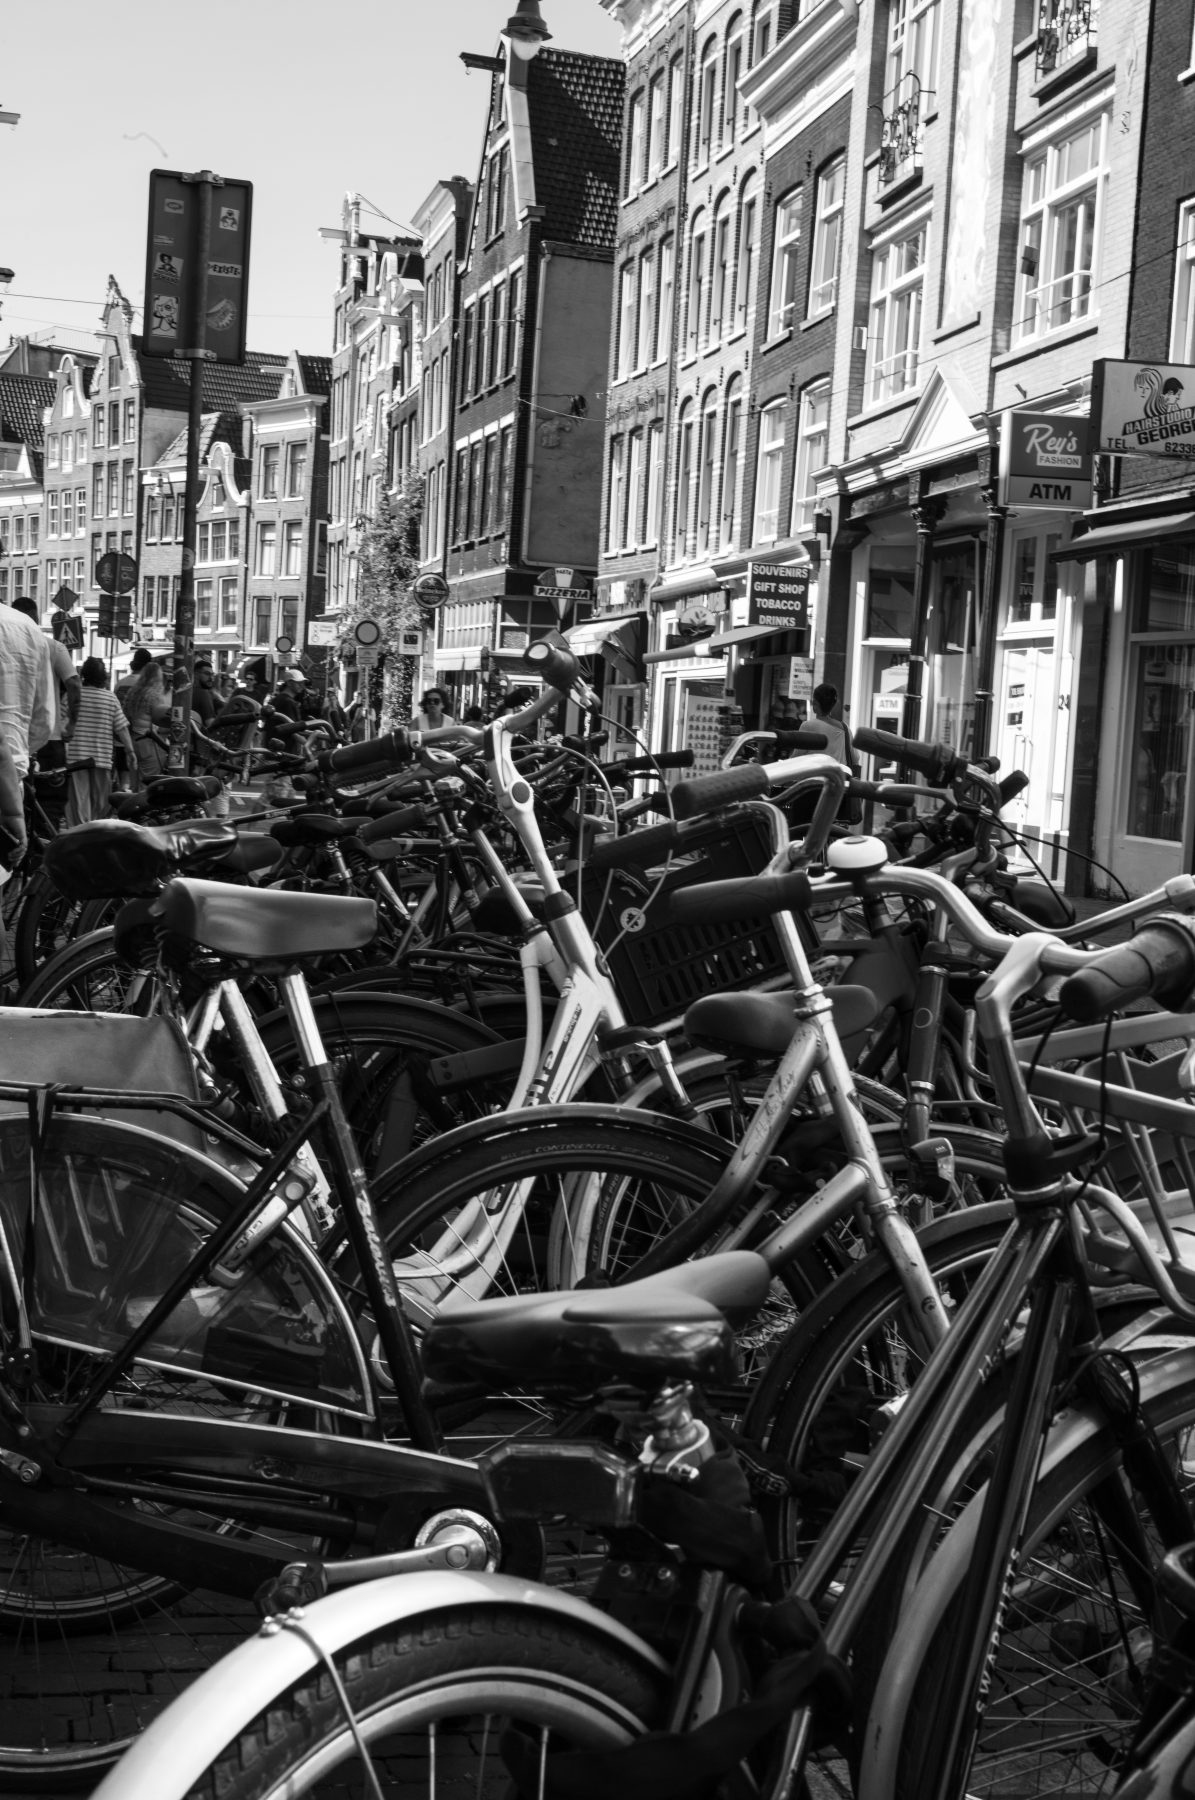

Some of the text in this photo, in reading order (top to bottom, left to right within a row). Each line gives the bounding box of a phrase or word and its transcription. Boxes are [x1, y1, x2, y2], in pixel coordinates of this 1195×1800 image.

[1125, 409, 1192, 433] HAIRSTUDIO
[1023, 423, 1078, 454] Rey's
[1039, 456, 1079, 466] FASHION
[1029, 483, 1071, 500] ATM
[753, 566, 808, 578] SOUVENIRS
[538, 588, 588, 598] PIZZERIA
[754, 582, 805, 594] GIFT SHOP
[755, 598, 801, 610] TOBACCO
[759, 615, 795, 626] DRINKS
[878, 698, 898, 709] ATM
[975, 1549, 1020, 1713] SWAPFIETS
